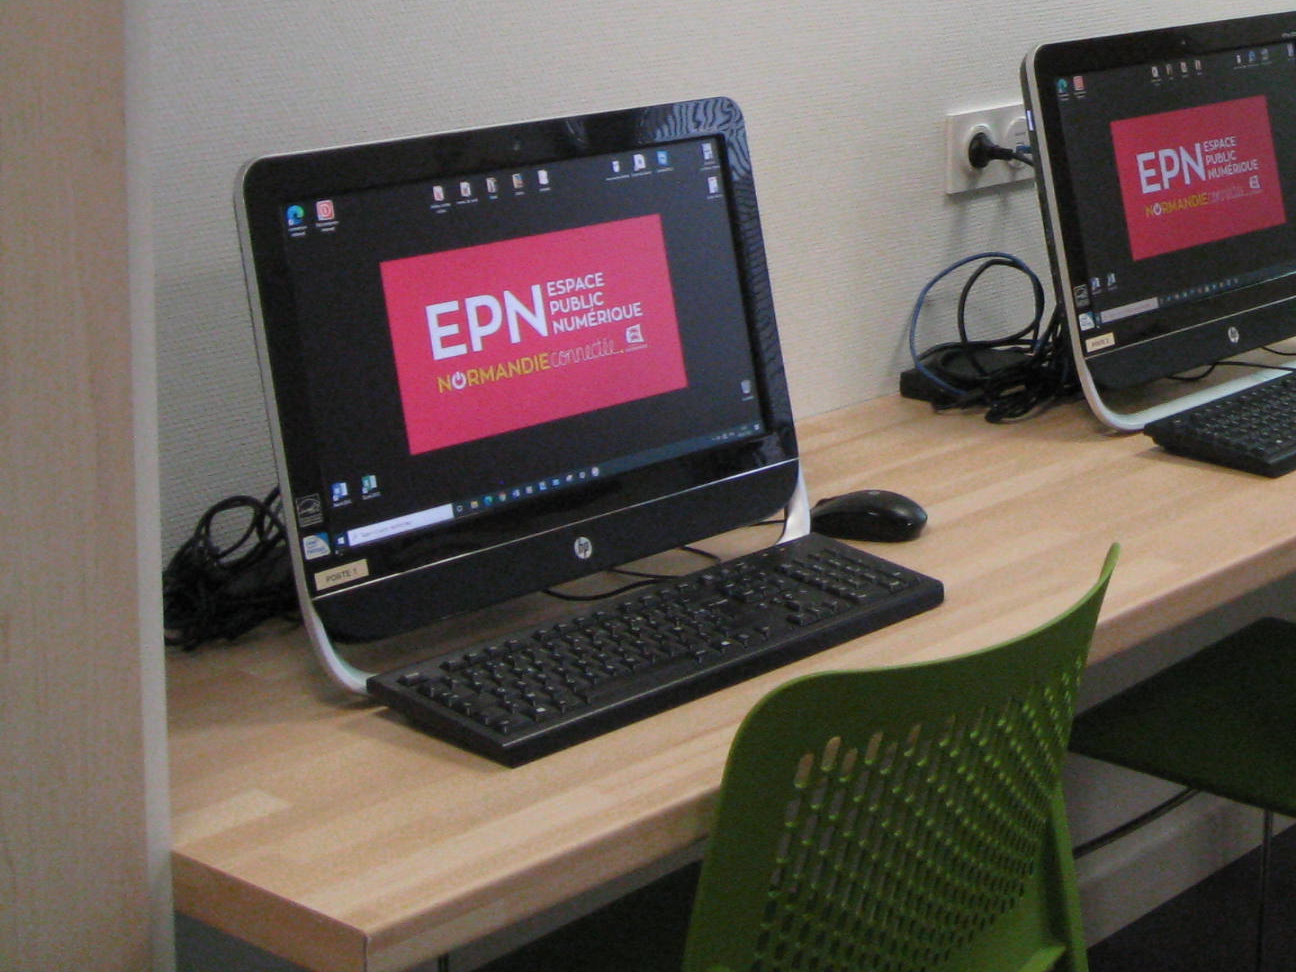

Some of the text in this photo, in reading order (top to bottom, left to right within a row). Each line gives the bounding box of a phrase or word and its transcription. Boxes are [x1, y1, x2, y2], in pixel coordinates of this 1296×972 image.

[1203, 136, 1237, 152] ESPACE
[1136, 142, 1206, 194] EPN
[1205, 150, 1237, 165] PUBLIC
[1145, 192, 1209, 217] NORMANDIE
[547, 272, 605, 296] ESPACE
[550, 292, 605, 315] PUBLIC
[425, 284, 549, 360] EPN
[552, 302, 644, 335] NUMÉRIQUE
[437, 353, 551, 393] NORMANDIE
[576, 537, 591, 559] hp
